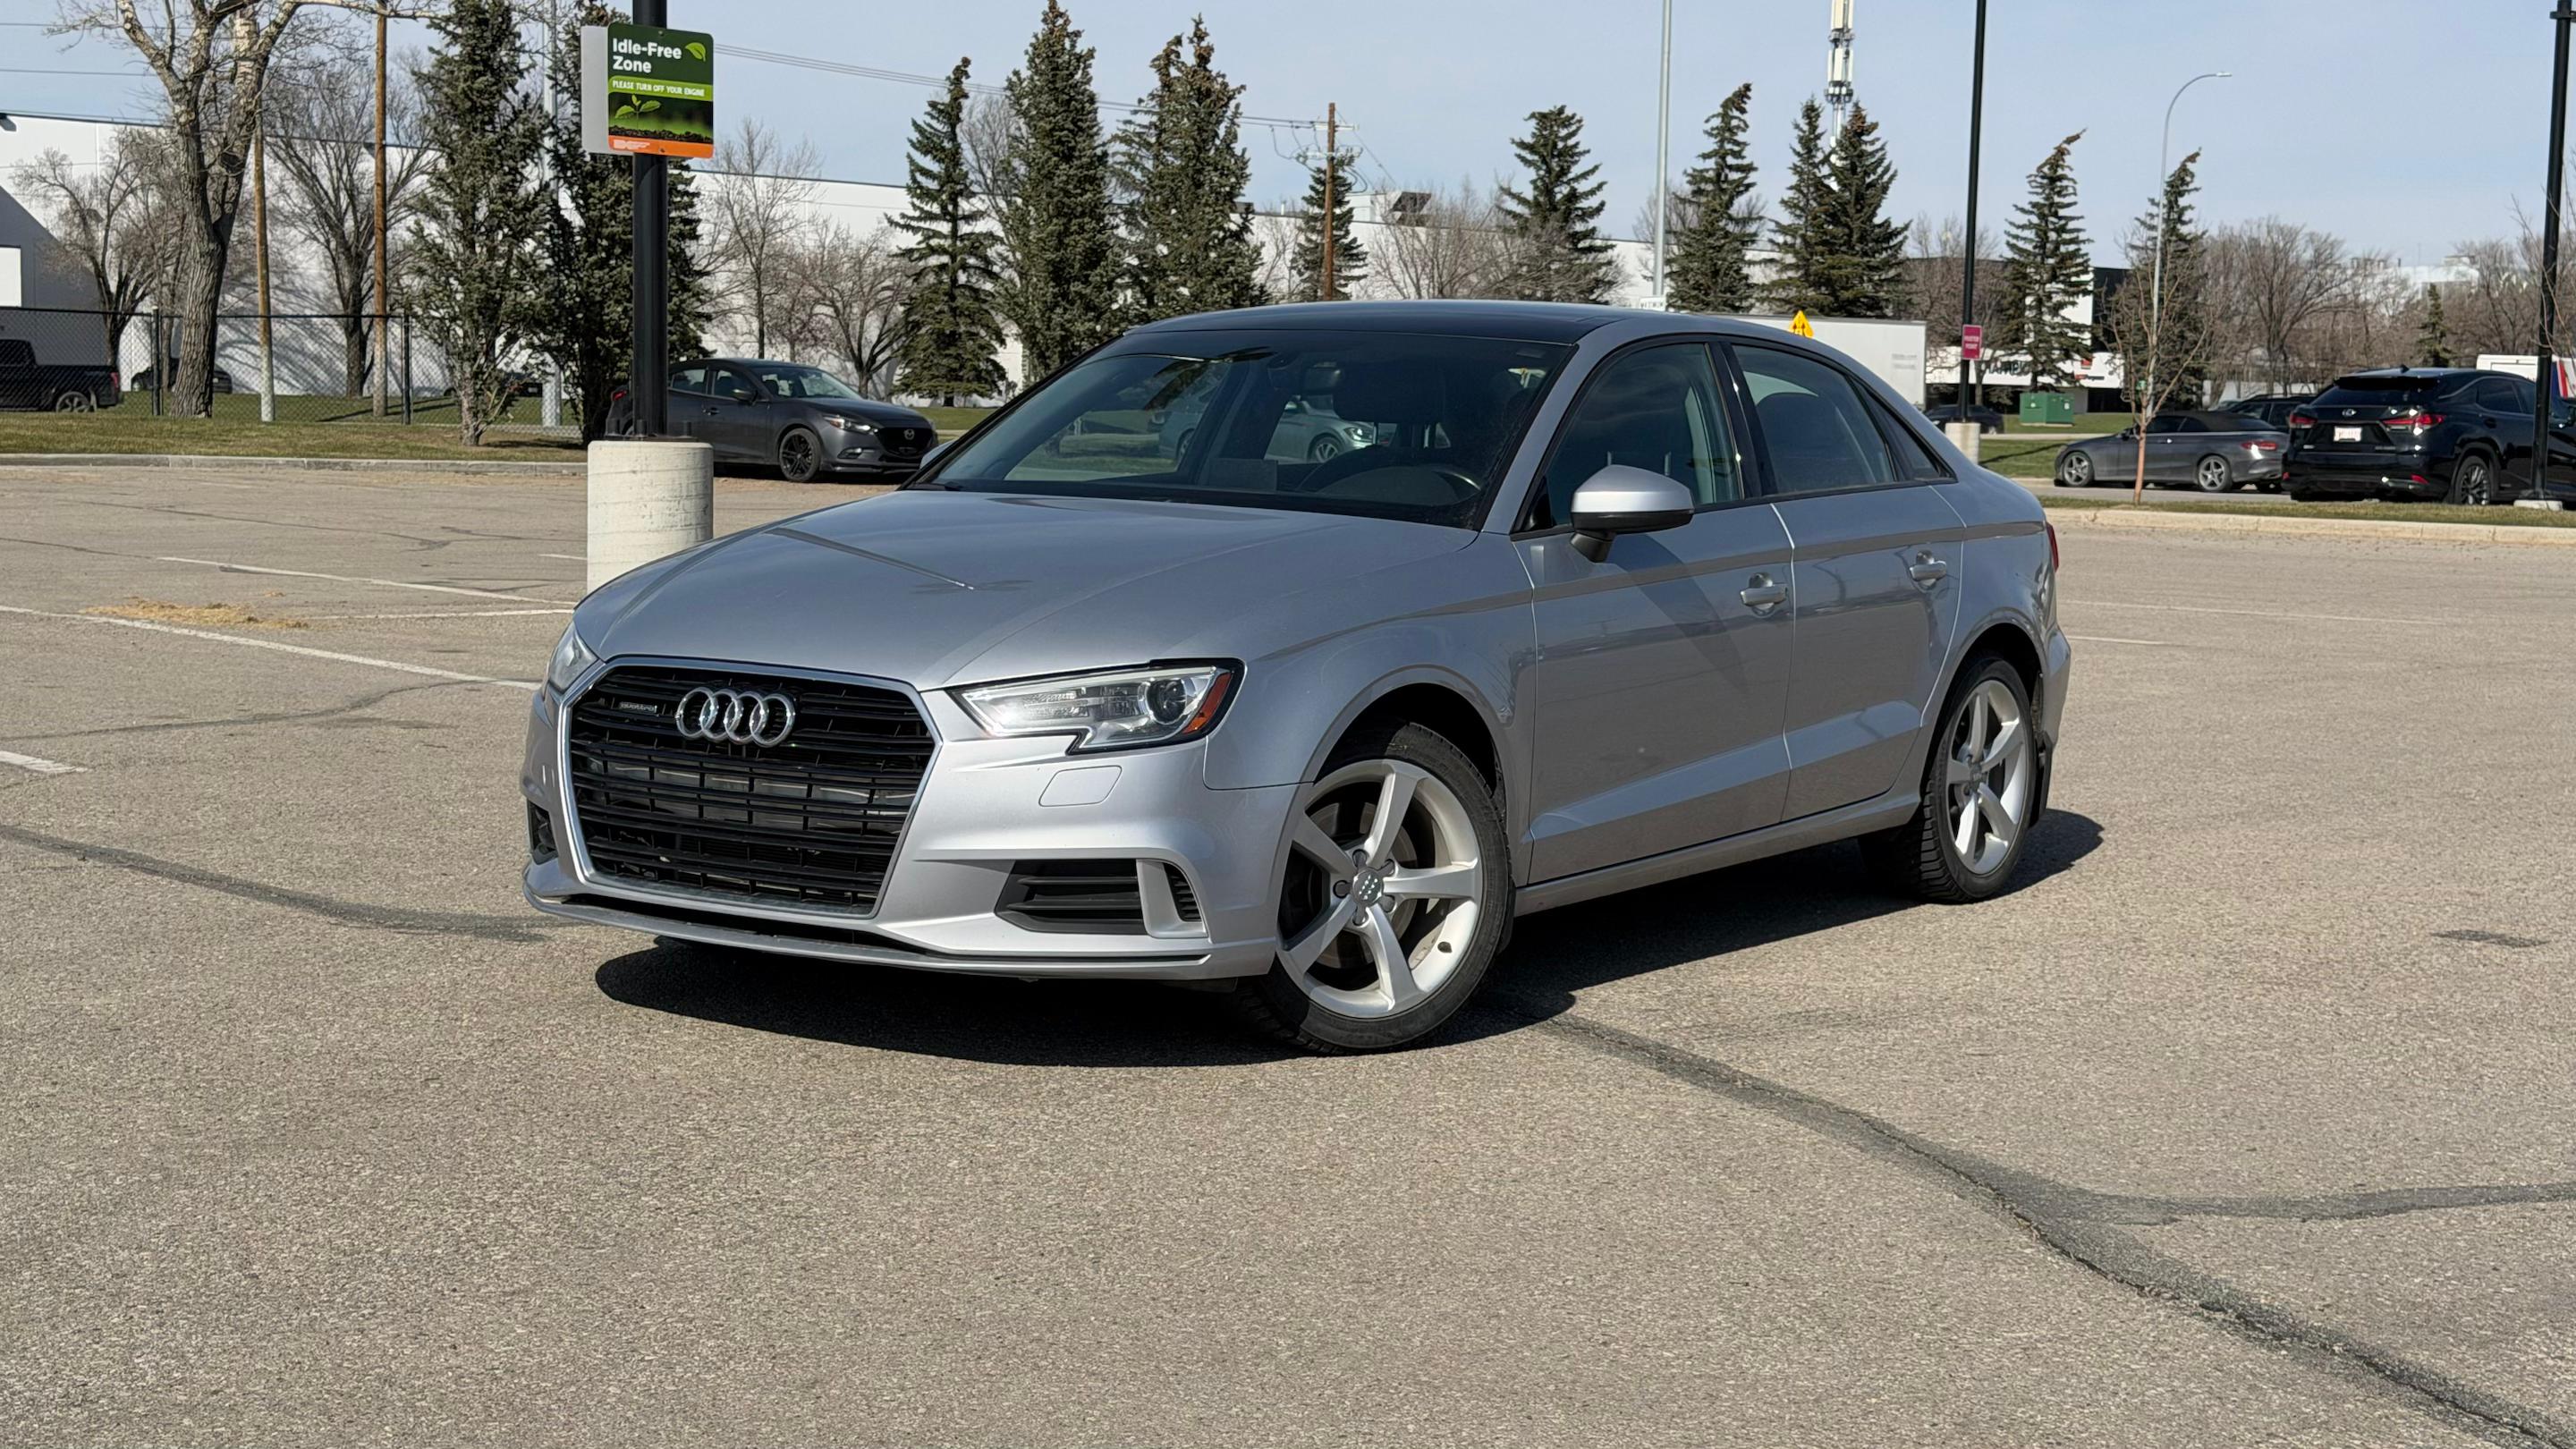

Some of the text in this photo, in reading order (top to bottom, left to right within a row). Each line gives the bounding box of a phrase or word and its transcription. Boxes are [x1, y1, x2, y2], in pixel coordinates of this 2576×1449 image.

[613, 38, 682, 59] Idle-Free
[613, 55, 651, 73] Zone
[613, 80, 634, 89] PLEASE
[636, 82, 652, 91] TURN
[653, 84, 665, 92] OFF
[666, 85, 683, 94] YOUR
